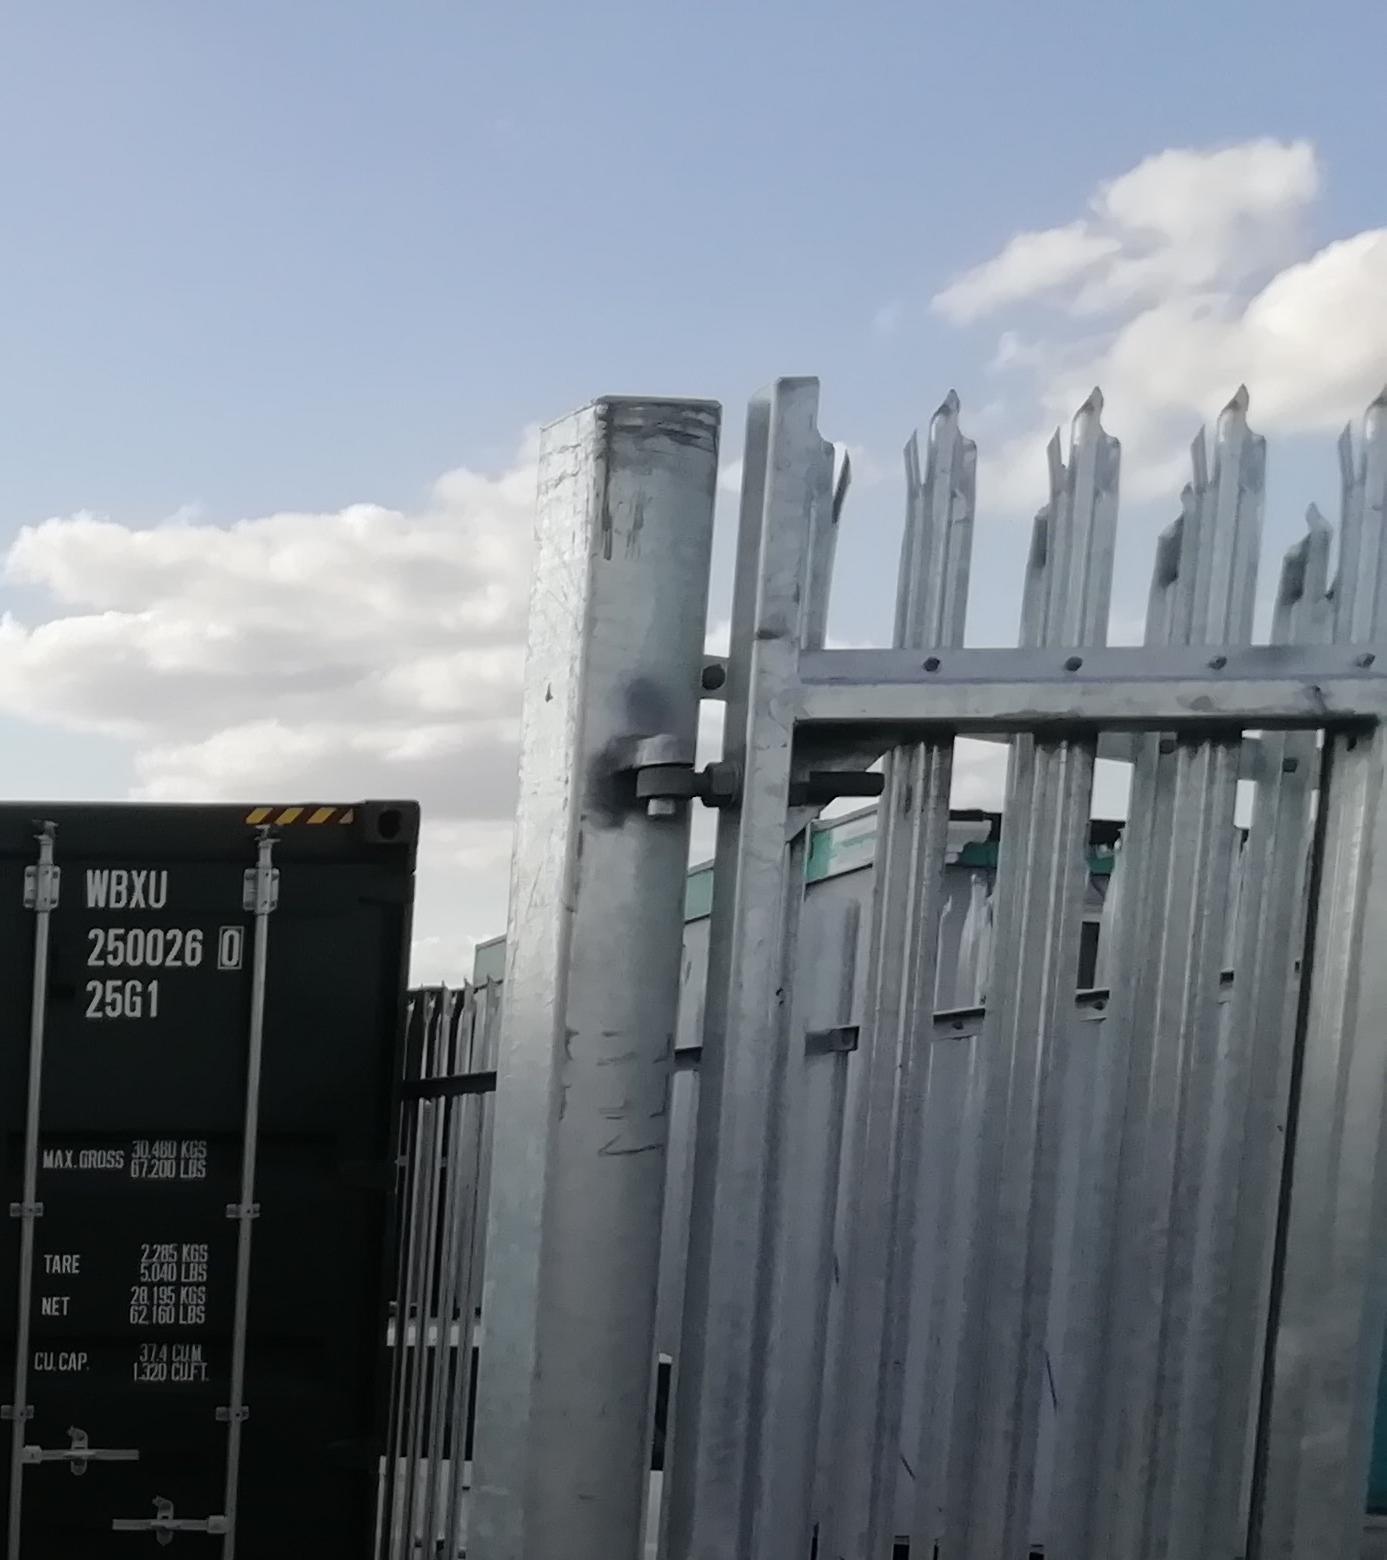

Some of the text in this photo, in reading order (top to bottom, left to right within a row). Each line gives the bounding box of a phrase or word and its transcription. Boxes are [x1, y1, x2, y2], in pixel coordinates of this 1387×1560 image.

[86, 869, 168, 908] WBXU
[87, 928, 204, 967] 250026
[85, 979, 159, 1018] 25G1
[181, 1140, 207, 1159] KGS
[180, 1159, 206, 1179] LBS
[182, 1243, 208, 1263] KGS
[44, 1254, 80, 1274] TARE
[140, 1263, 208, 1282] 5.040 LBS
[180, 1286, 206, 1305] KGS
[41, 1297, 70, 1316] NET
[179, 1305, 205, 1324] LBS
